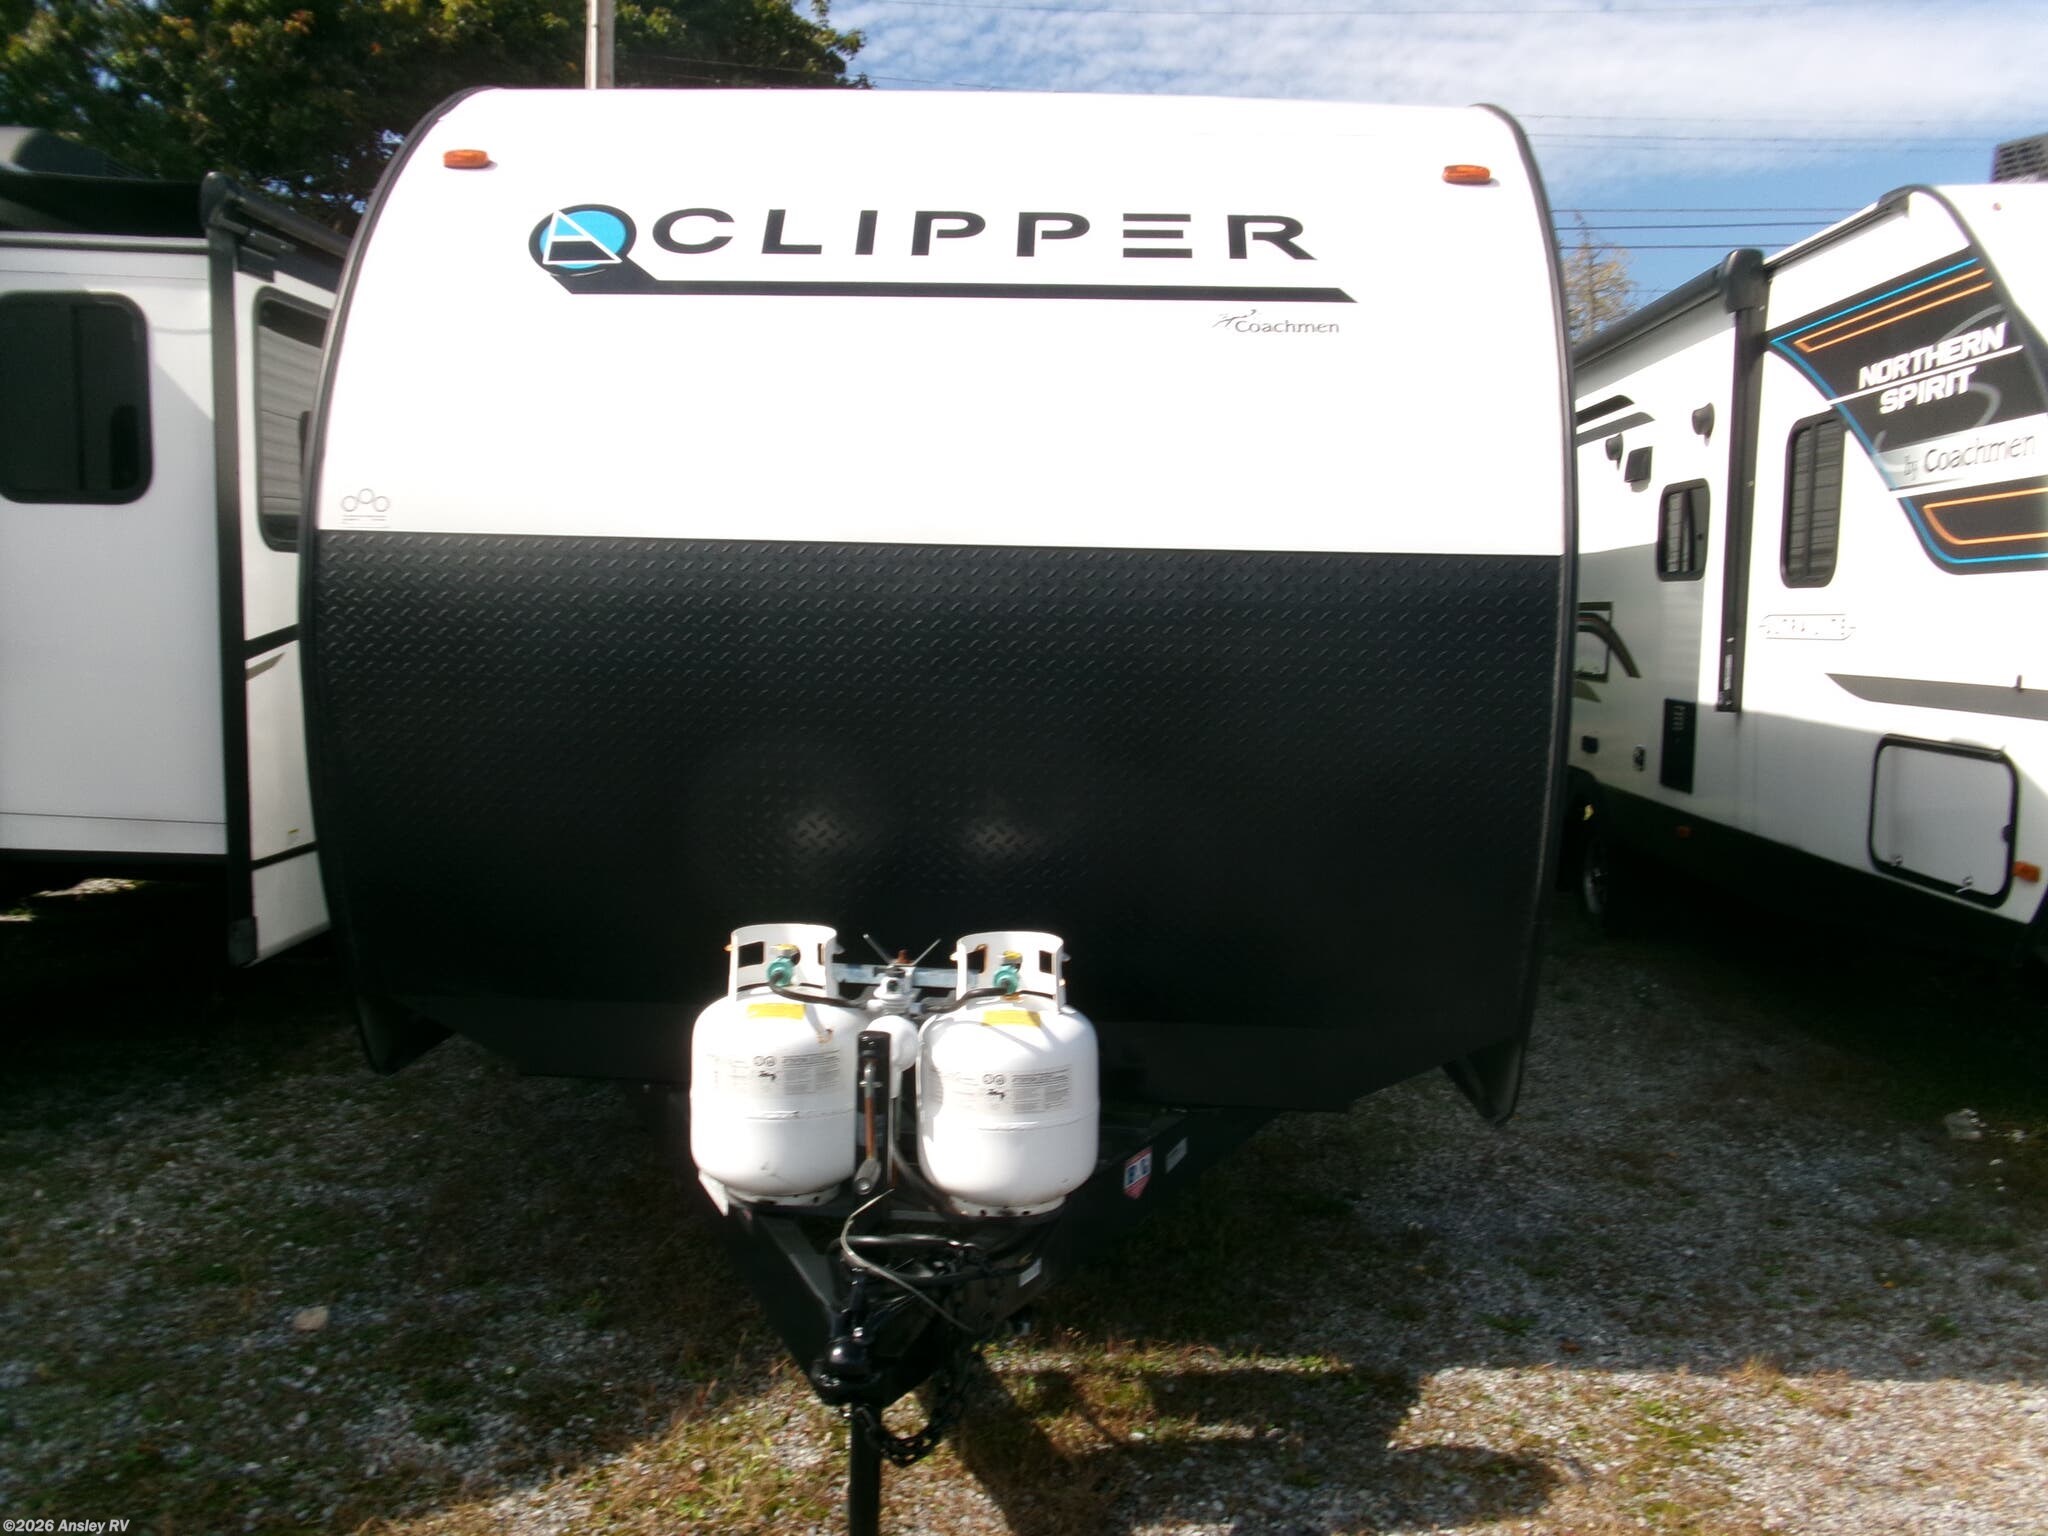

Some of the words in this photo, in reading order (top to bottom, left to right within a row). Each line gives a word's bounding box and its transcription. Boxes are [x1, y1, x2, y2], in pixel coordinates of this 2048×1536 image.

[652, 207, 1318, 260] CLIPPER
[1233, 315, 1340, 334] Coachmen
[1857, 321, 2010, 391] NORTHERN
[1879, 365, 1977, 415] SPIRIT
[1923, 431, 2036, 474] Coachmen
